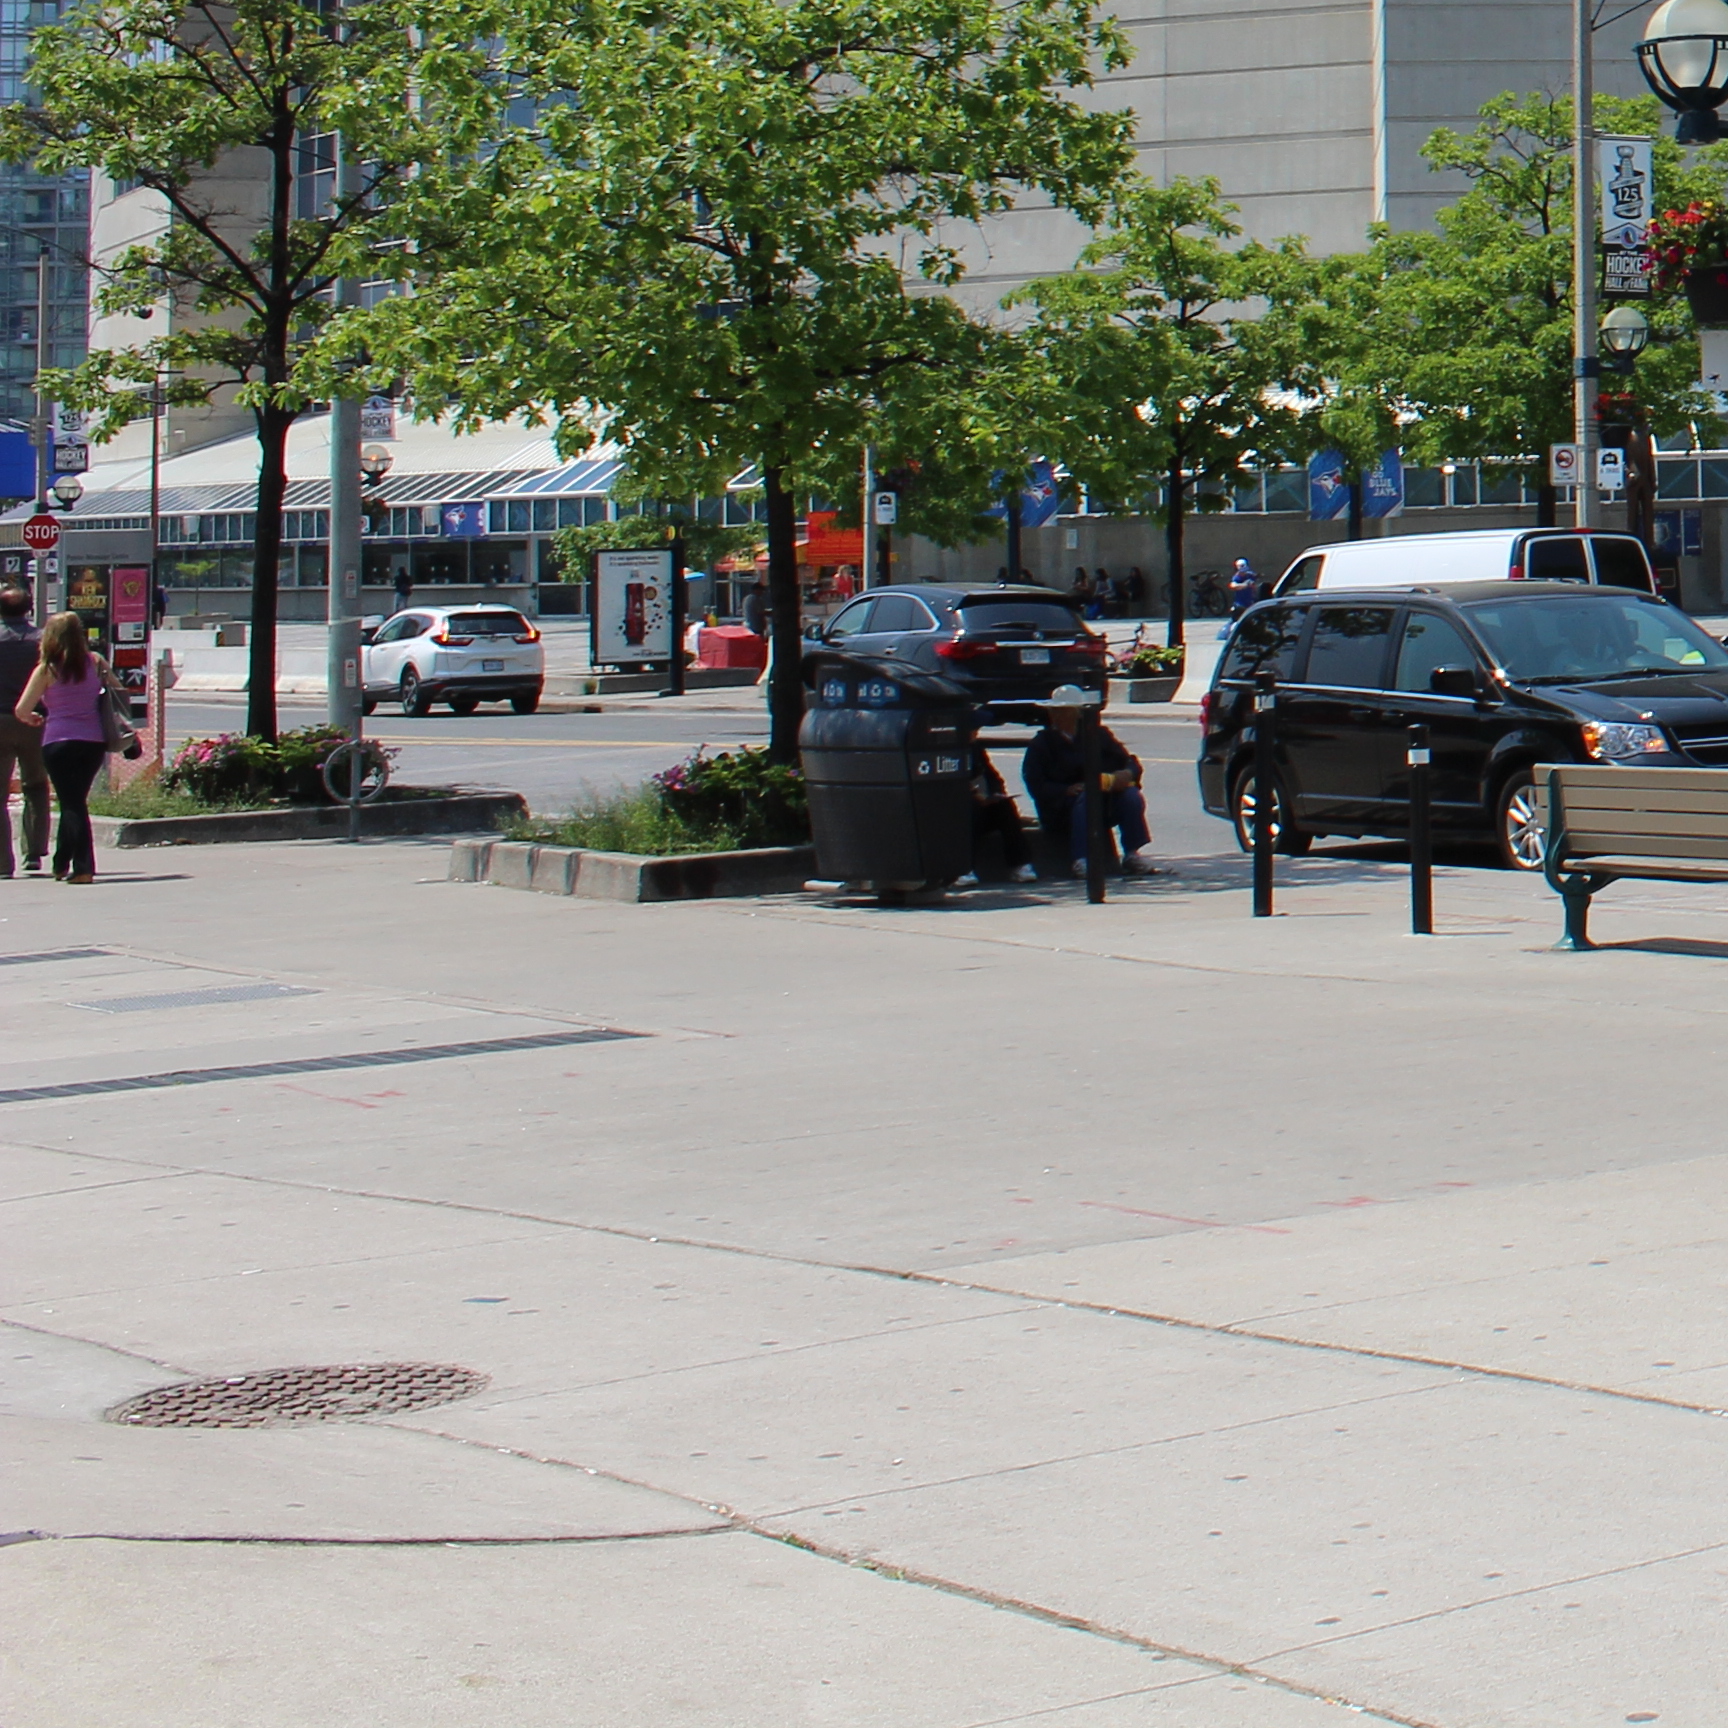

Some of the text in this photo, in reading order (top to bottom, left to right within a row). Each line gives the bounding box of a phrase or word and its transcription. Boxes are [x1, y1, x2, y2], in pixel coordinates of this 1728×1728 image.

[1617, 187, 1639, 201] 125
[1369, 478, 1392, 487] BLUE
[25, 525, 59, 539] STOP
[936, 756, 960, 773] Litter
